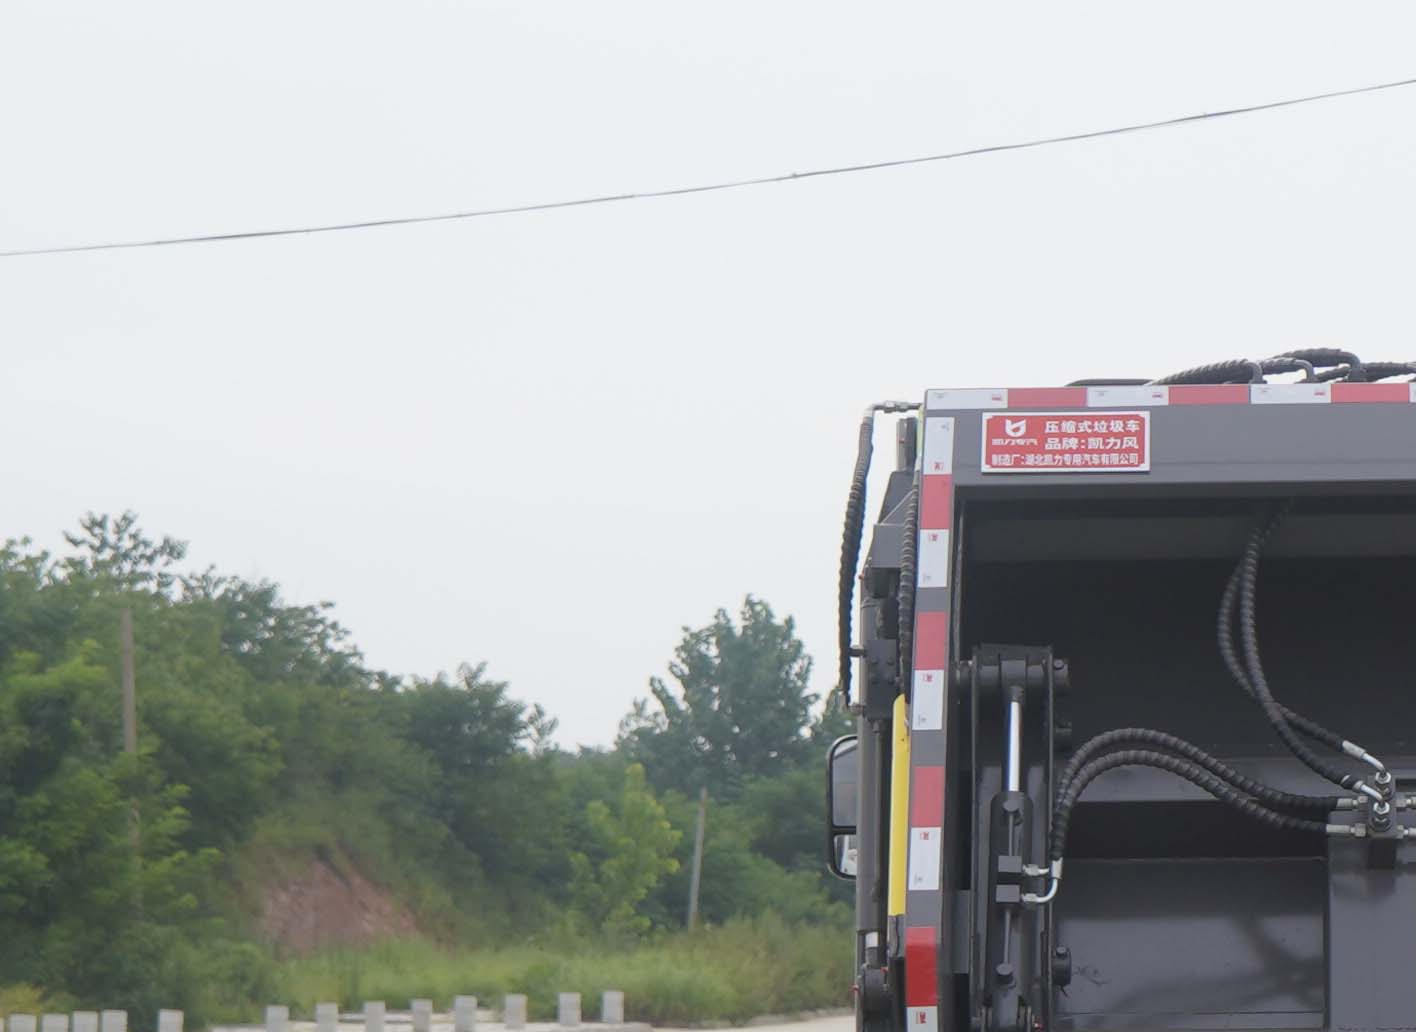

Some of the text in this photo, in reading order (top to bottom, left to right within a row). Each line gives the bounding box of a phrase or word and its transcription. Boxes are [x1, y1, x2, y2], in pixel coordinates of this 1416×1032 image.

[1044, 420, 1140, 433] 压缩式垃圾车
